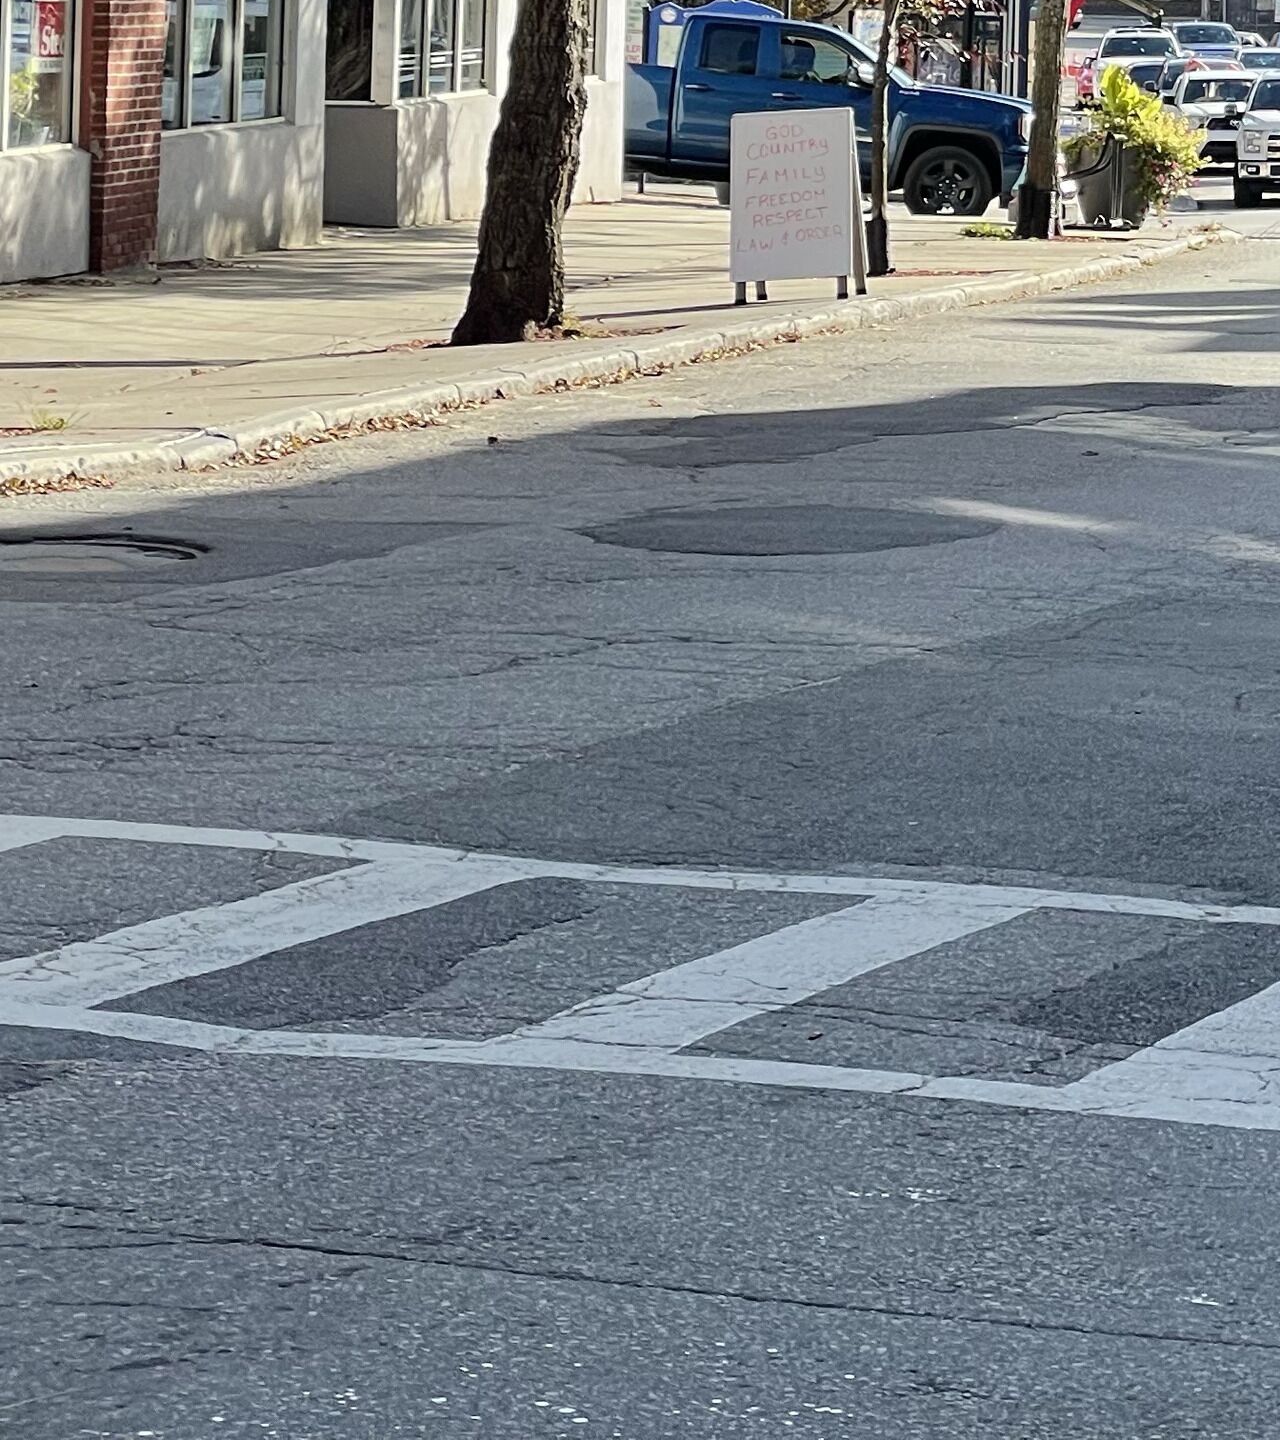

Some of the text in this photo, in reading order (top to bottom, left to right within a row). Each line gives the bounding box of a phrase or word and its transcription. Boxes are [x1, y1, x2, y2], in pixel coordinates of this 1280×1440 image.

[765, 124, 804, 141] GOD
[744, 189, 826, 210] FREEDOM
[752, 206, 829, 229] RESPECT
[735, 237, 774, 253] LAW
[795, 224, 842, 242] ORDER
